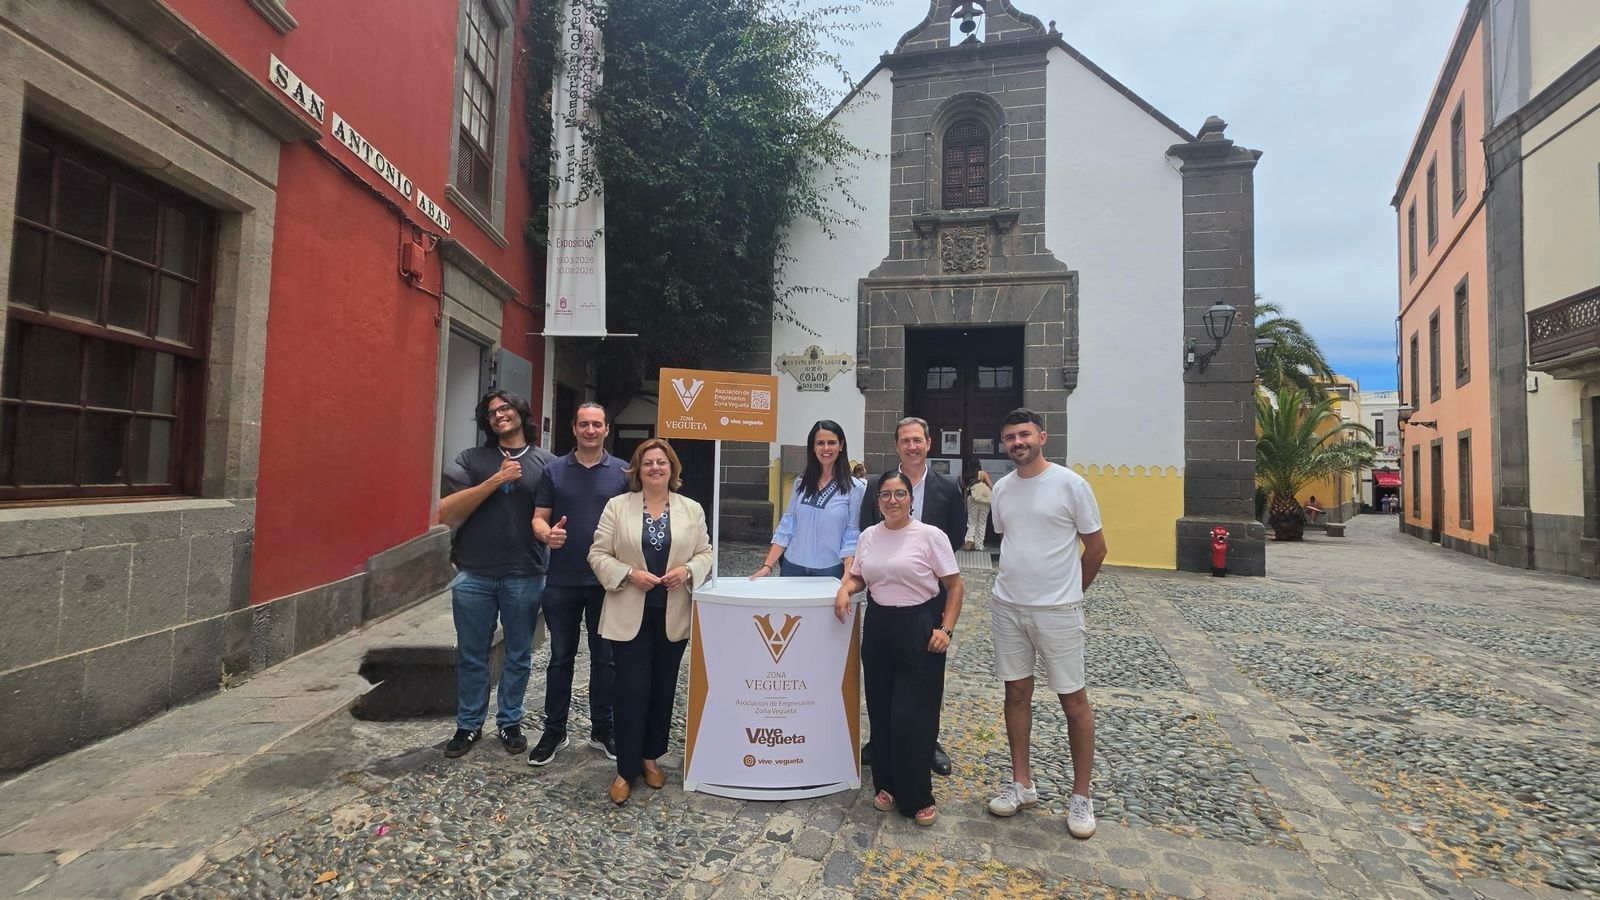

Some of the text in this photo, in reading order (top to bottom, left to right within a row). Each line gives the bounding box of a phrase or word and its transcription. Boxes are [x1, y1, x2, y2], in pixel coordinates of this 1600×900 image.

[274, 63, 451, 231] SAN ANTONIO ABAD
[564, 143, 575, 184] Art al
[556, 237, 594, 249] Exposición
[714, 387, 742, 395] Asociación
[714, 394, 746, 402] Empresarios
[727, 401, 749, 409] Vegueta
[665, 421, 708, 431] VEGUETA
[766, 671, 787, 679] ZONA
[745, 679, 808, 691] VEGUETA
[735, 699, 815, 708] Asociación de Empresarios
[771, 707, 797, 715] Vegueta
[745, 727, 783, 743] Vive
[758, 758, 804, 767] vive_vegueta
